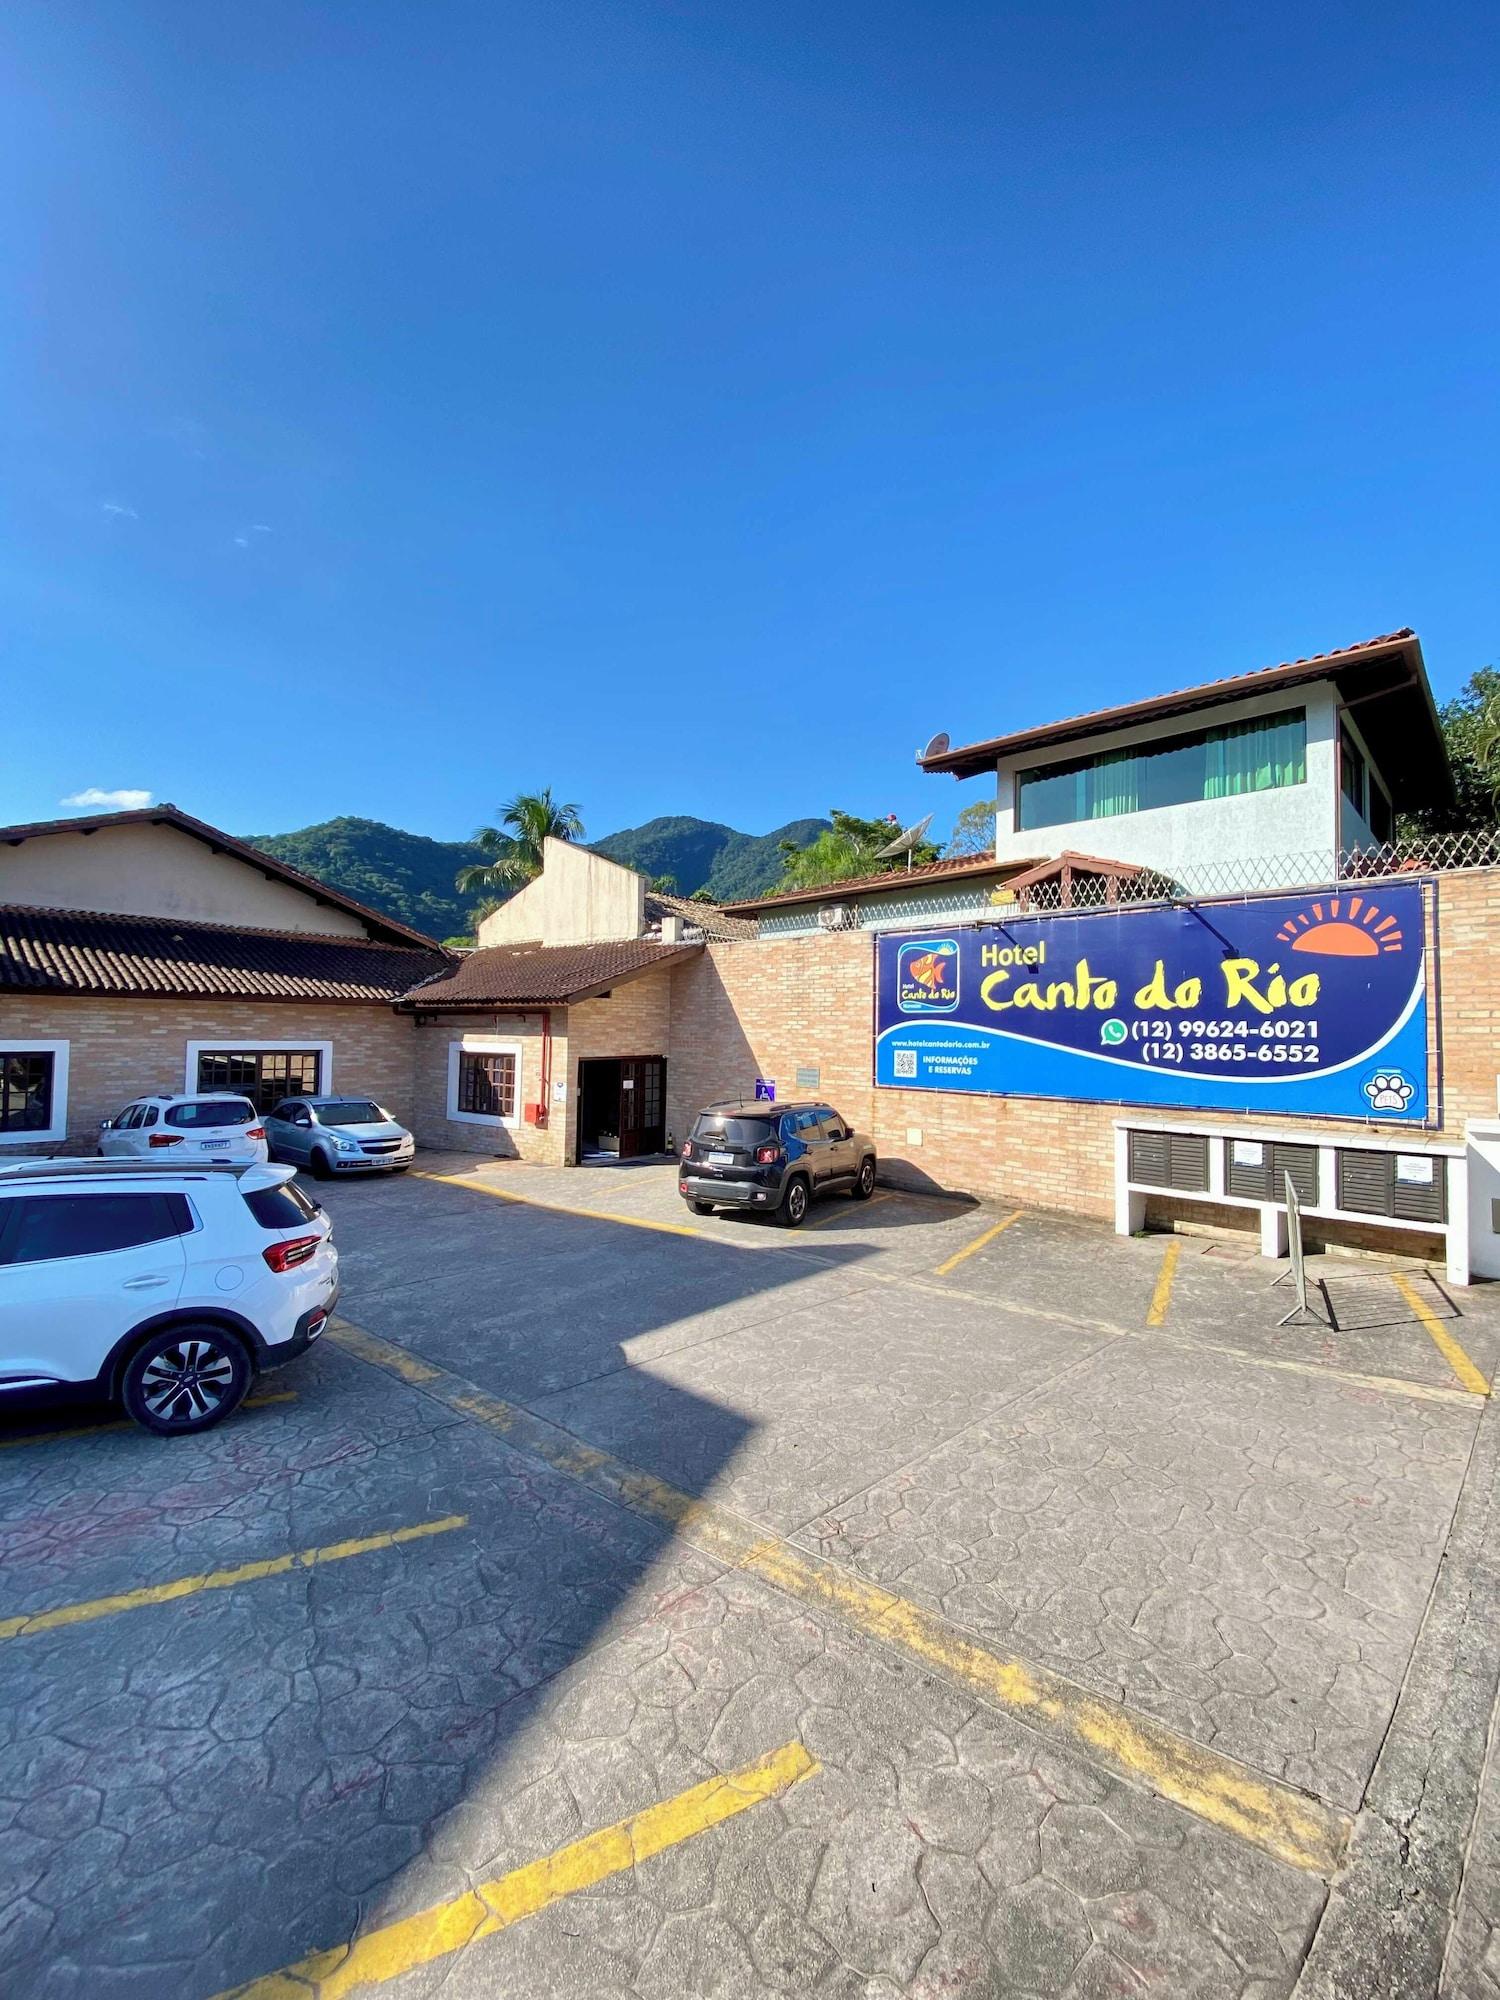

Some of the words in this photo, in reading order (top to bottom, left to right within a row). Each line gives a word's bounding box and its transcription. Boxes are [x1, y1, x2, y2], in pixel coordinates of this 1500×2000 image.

[981, 941, 1045, 966] Hotel
[980, 959, 1118, 1011] Canto
[1134, 960, 1203, 1010] do
[1221, 958, 1321, 1014] Rio
[902, 988, 927, 999] Canto
[928, 989, 940, 999] do
[941, 988, 955, 999] Rio
[1131, 1020, 1172, 1041] (12)
[1178, 1020, 1318, 1039] 99624-6021
[891, 1039, 991, 1049] www.hotelcantodorio.com.br
[1142, 1042, 1184, 1063] (12)
[1190, 1043, 1320, 1063] 3865-6552
[923, 1055, 978, 1066] INFORMAÇÕES
[928, 1066, 933, 1074] E
[934, 1066, 972, 1076] RESERVAS
[1379, 1094, 1398, 1106] PETS
